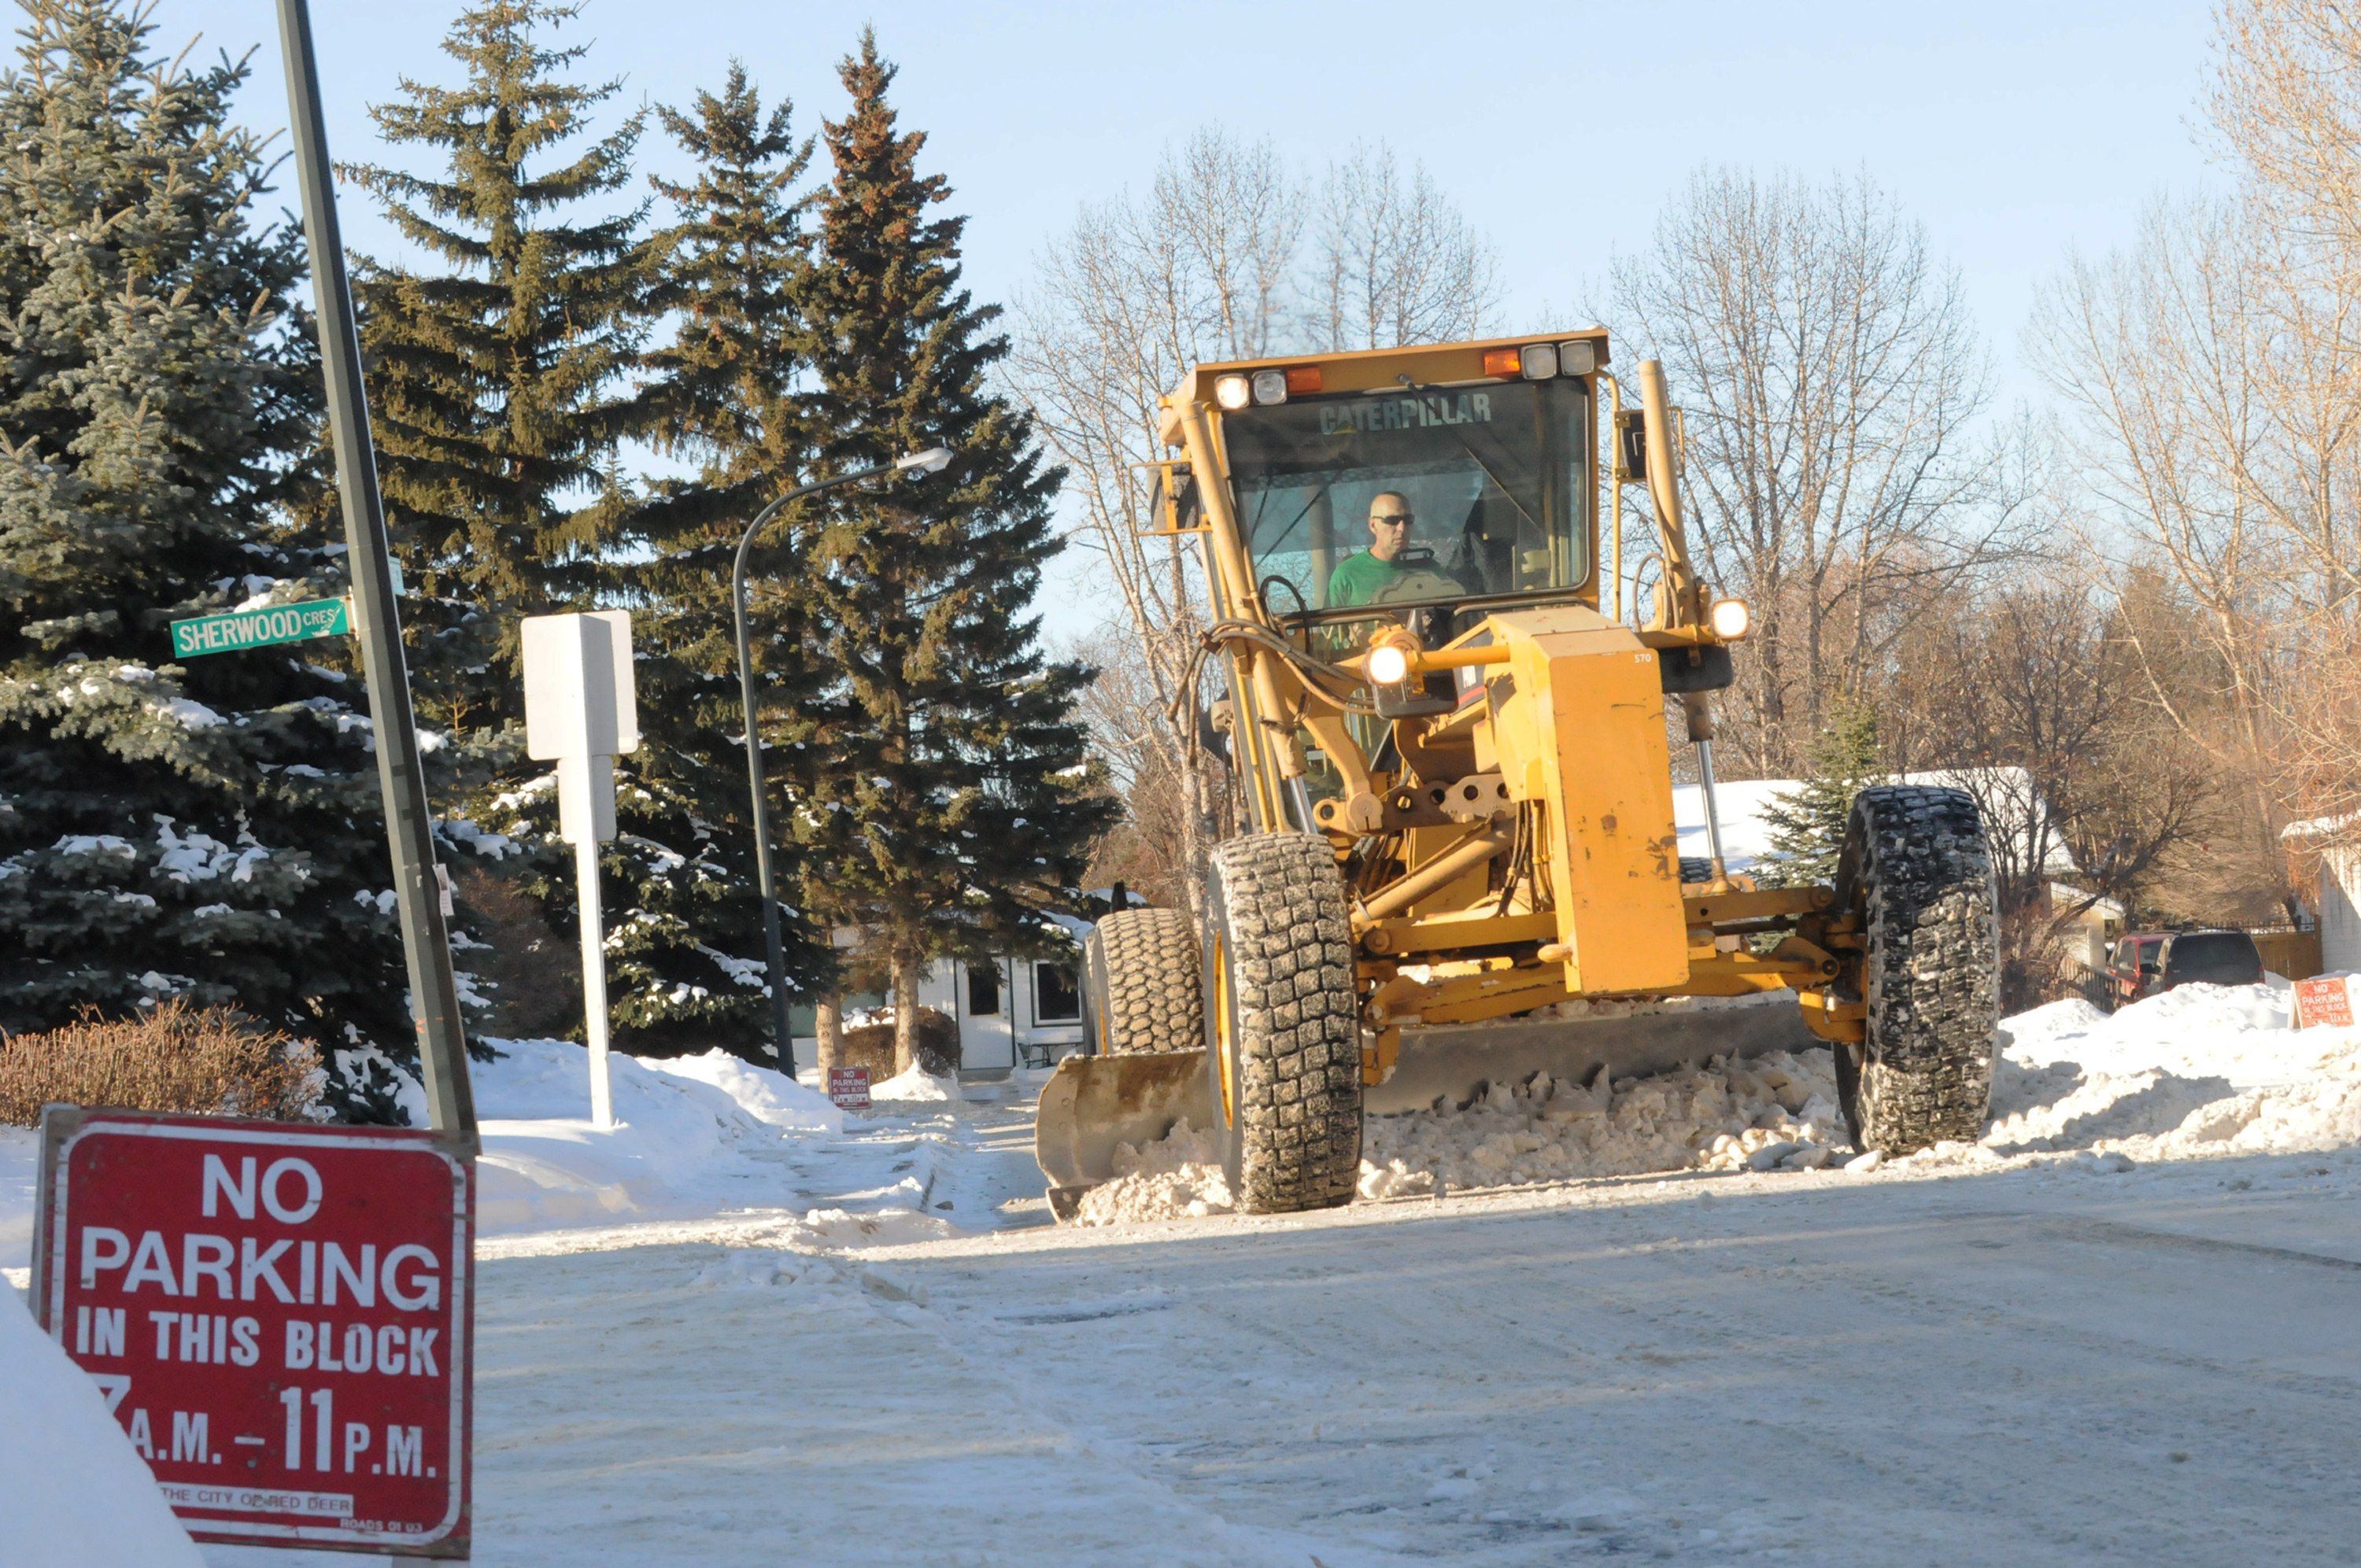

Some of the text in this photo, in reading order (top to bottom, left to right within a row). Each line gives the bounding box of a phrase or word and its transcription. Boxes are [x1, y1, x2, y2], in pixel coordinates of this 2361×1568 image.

[1319, 393, 1492, 436] CATERPILLAR
[178, 608, 336, 652] SHERWOOD CRES
[1634, 653, 1652, 663] 570
[2302, 992, 2345, 1005] PARKING
[2314, 983, 2329, 994] NO
[833, 1078, 866, 1087] PARKING
[202, 1154, 323, 1224] NO
[81, 1226, 440, 1312] PARKING
[76, 1305, 439, 1378] IN THIS BLOCK
[129, 1408, 222, 1465] A.M.
[279, 1386, 333, 1472] 11
[345, 1422, 437, 1478] P.M.
[160, 1487, 190, 1501] THE
[197, 1489, 233, 1504] CITY
[268, 1494, 301, 1509] RED
[308, 1496, 351, 1511] DEER
[340, 1518, 384, 1532] ROADS
